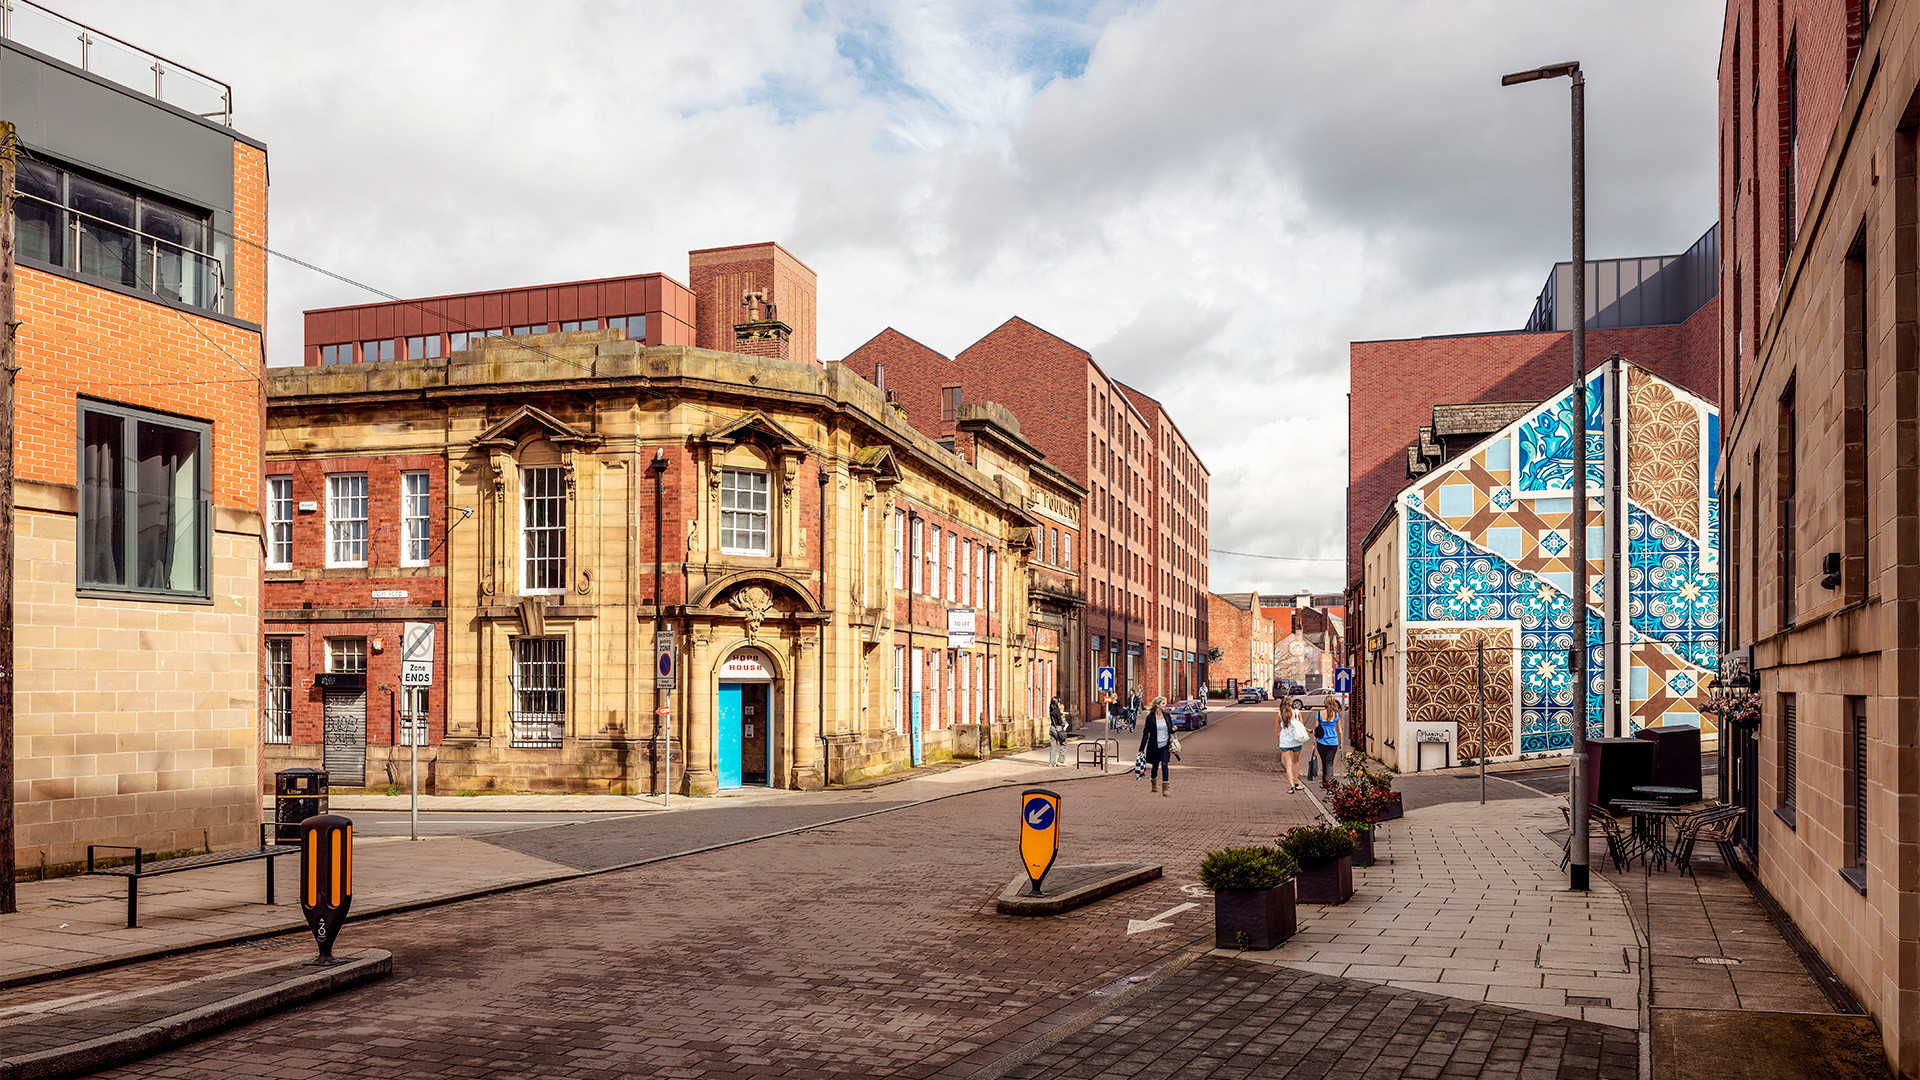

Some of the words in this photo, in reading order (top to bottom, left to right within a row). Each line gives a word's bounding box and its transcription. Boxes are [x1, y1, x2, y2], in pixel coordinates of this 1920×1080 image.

[1044, 493, 1080, 522] FOUNDRY
[410, 664, 426, 672] Zone
[405, 673, 430, 682] ENDS
